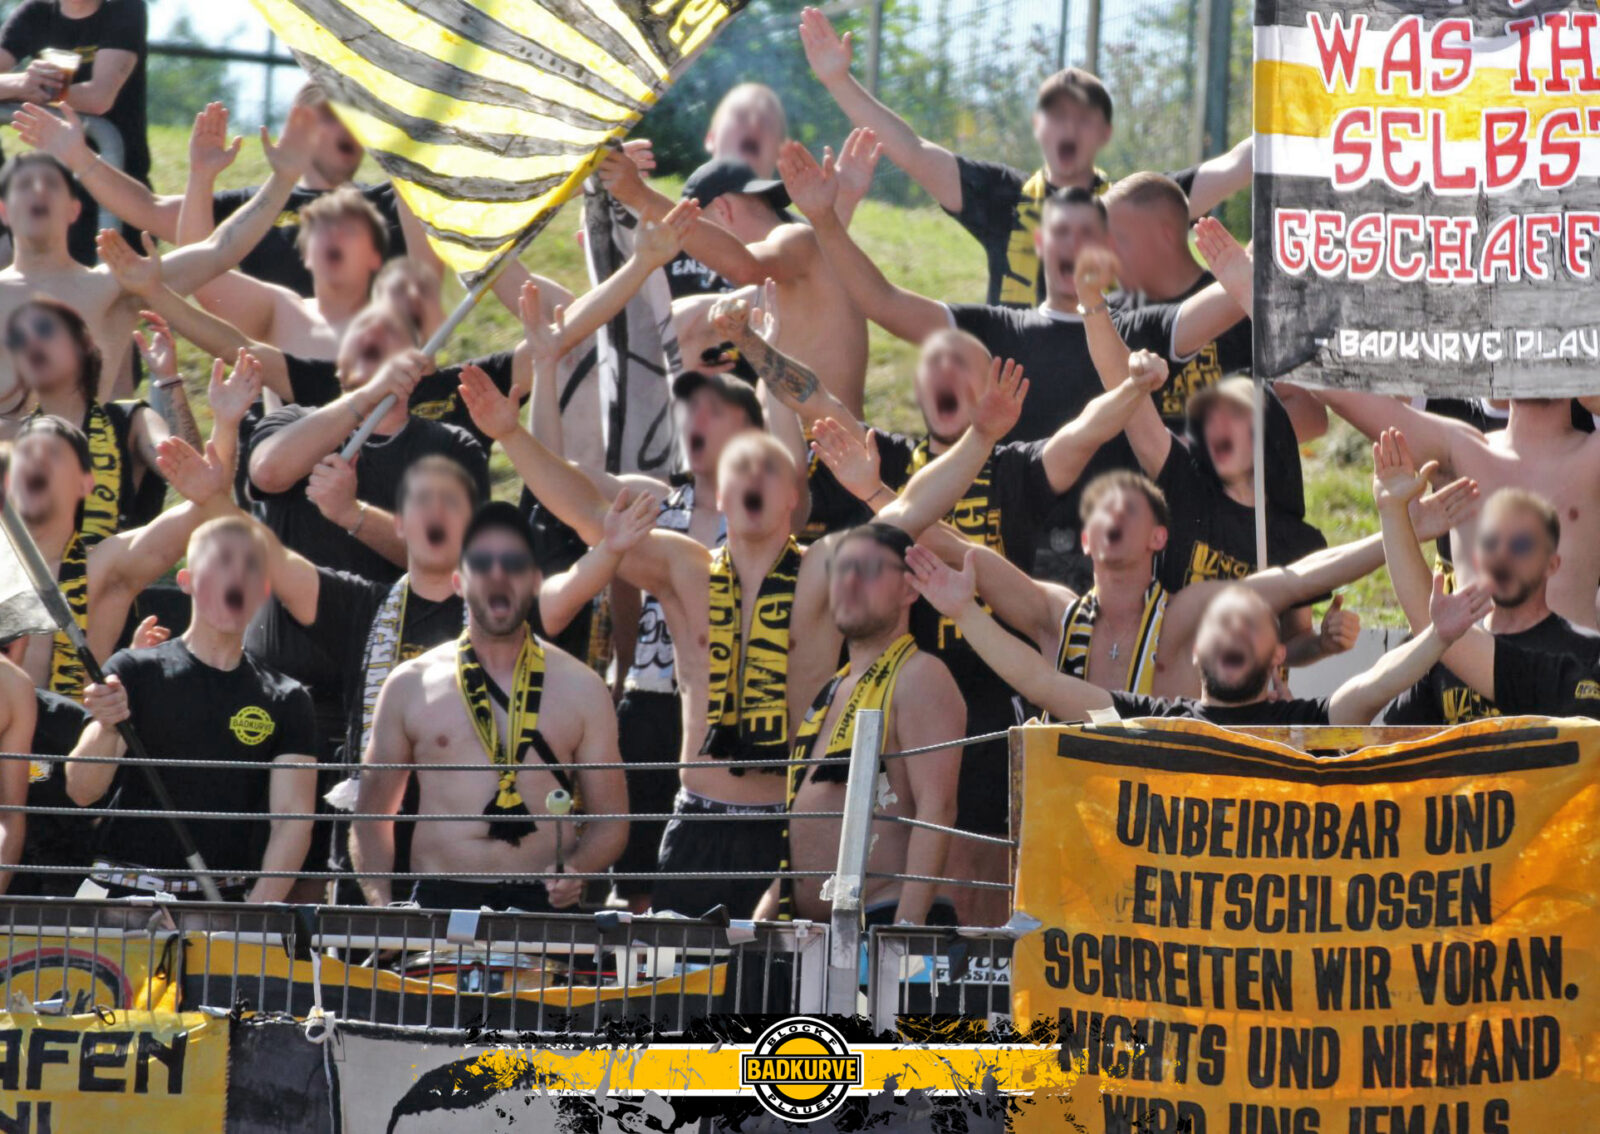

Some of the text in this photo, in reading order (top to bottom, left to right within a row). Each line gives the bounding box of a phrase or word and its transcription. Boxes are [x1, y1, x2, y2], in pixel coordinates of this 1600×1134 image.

[1307, 13, 1473, 92] WAS
[1332, 107, 1600, 193] SELBS
[1276, 208, 1600, 282] GESCHAFF
[1116, 780, 1516, 859] UNBEIRRBAR UND
[1132, 863, 1492, 934] ENTSCHLOSSEN
[1043, 928, 1580, 1012] SCHREITEN WIR VORAN.
[1057, 1007, 1561, 1090] NICHTS UND NIEMAND
